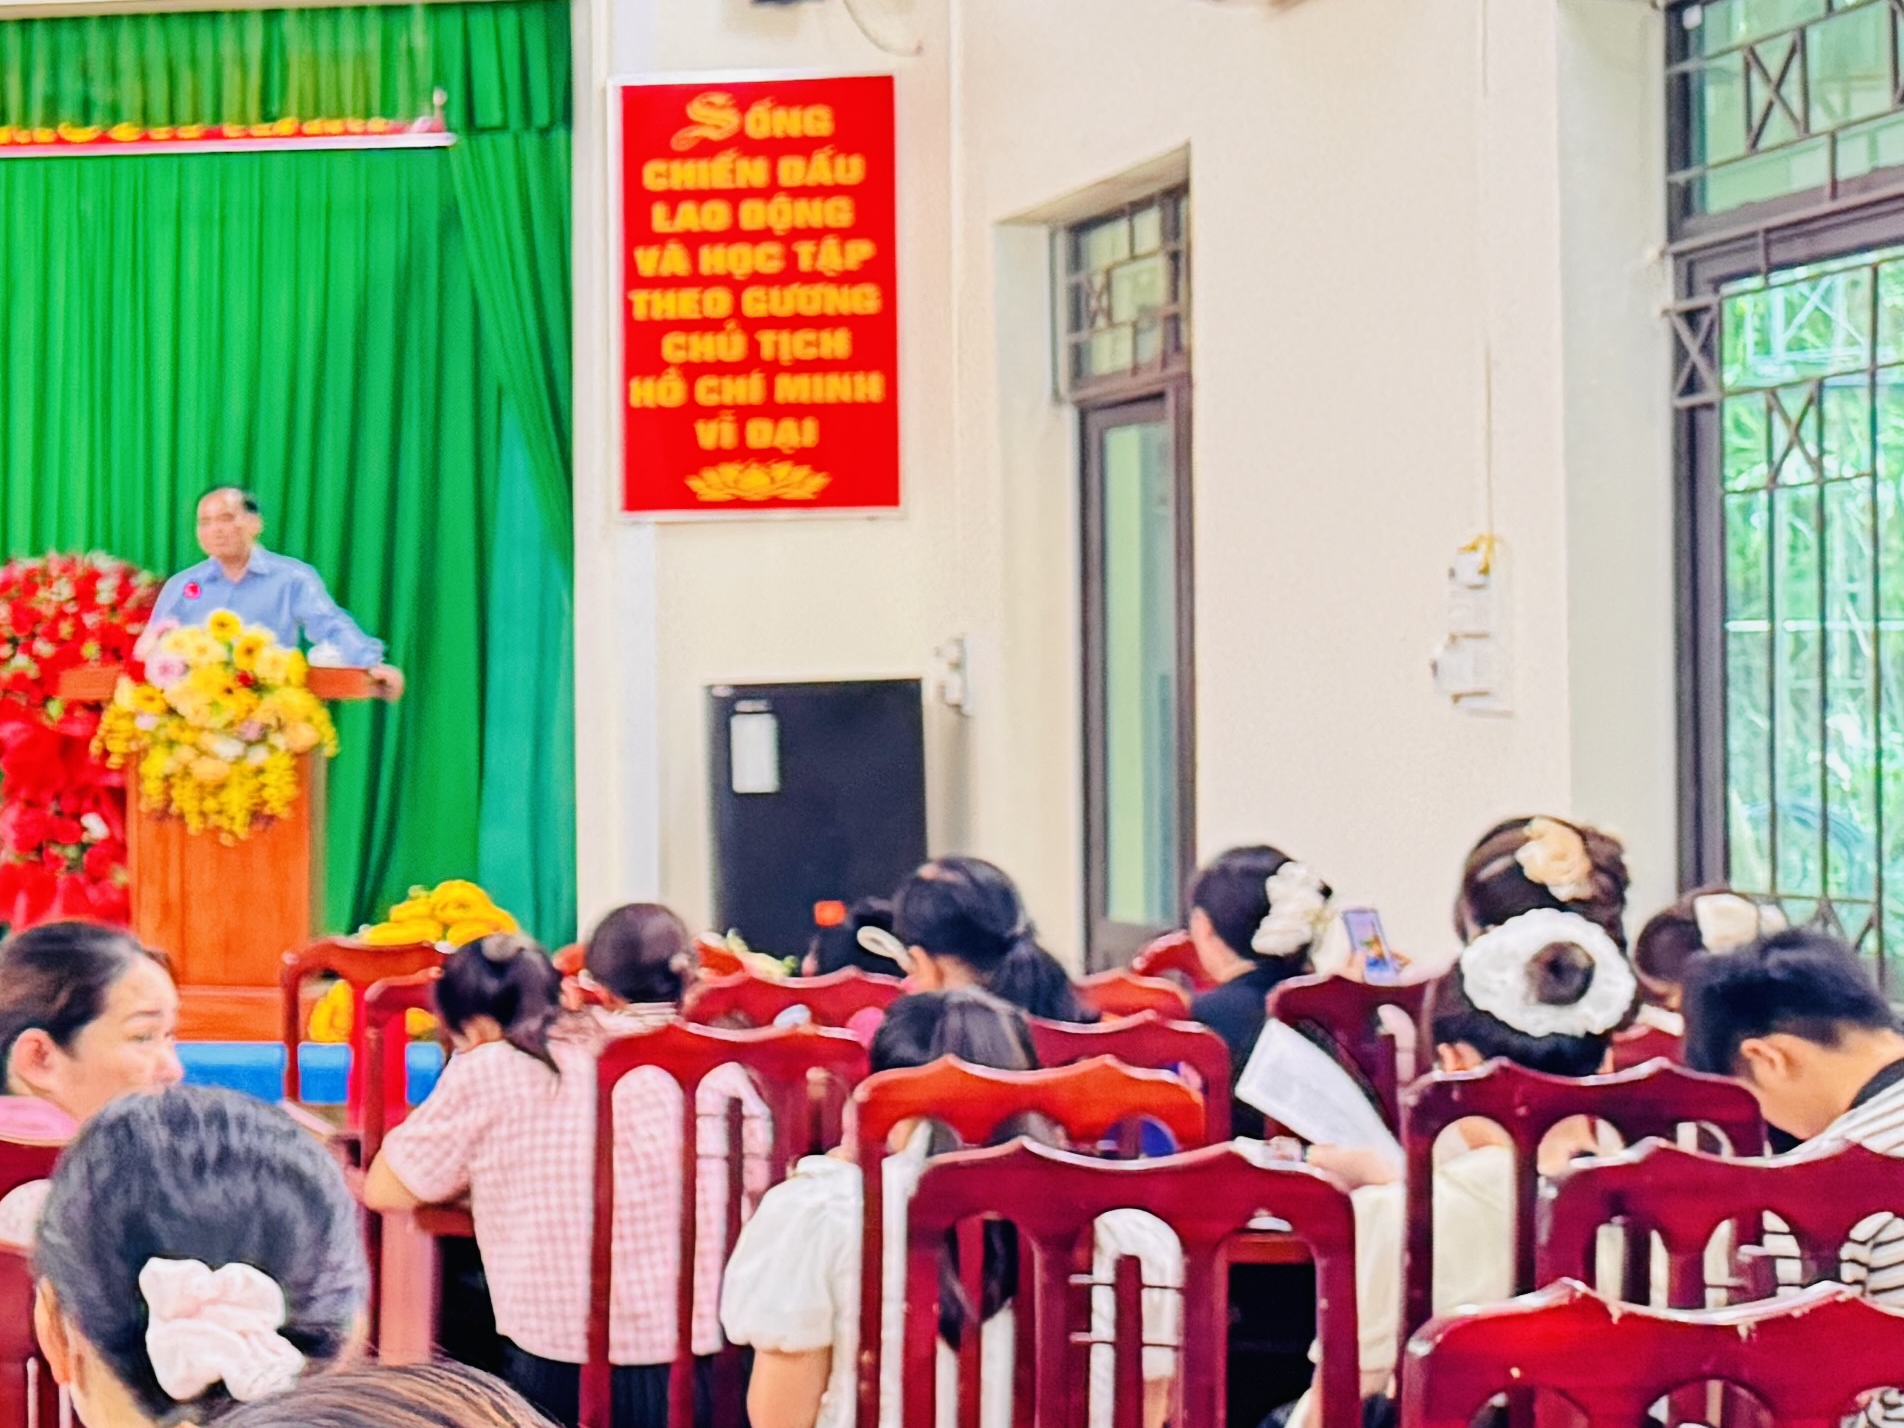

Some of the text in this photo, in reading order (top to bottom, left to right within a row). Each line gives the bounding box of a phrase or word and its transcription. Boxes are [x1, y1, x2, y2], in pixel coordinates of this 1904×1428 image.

[642, 147, 771, 191] CHIẾN
[651, 191, 855, 236] LAO ĐỘNG
[633, 234, 878, 281] VÀ HỌC TẬP
[627, 286, 735, 321] THEO
[661, 318, 853, 366] CHỦ TỊCH
[628, 364, 886, 409] HỒ CHÍ MINH
[694, 408, 739, 450] VĨ
